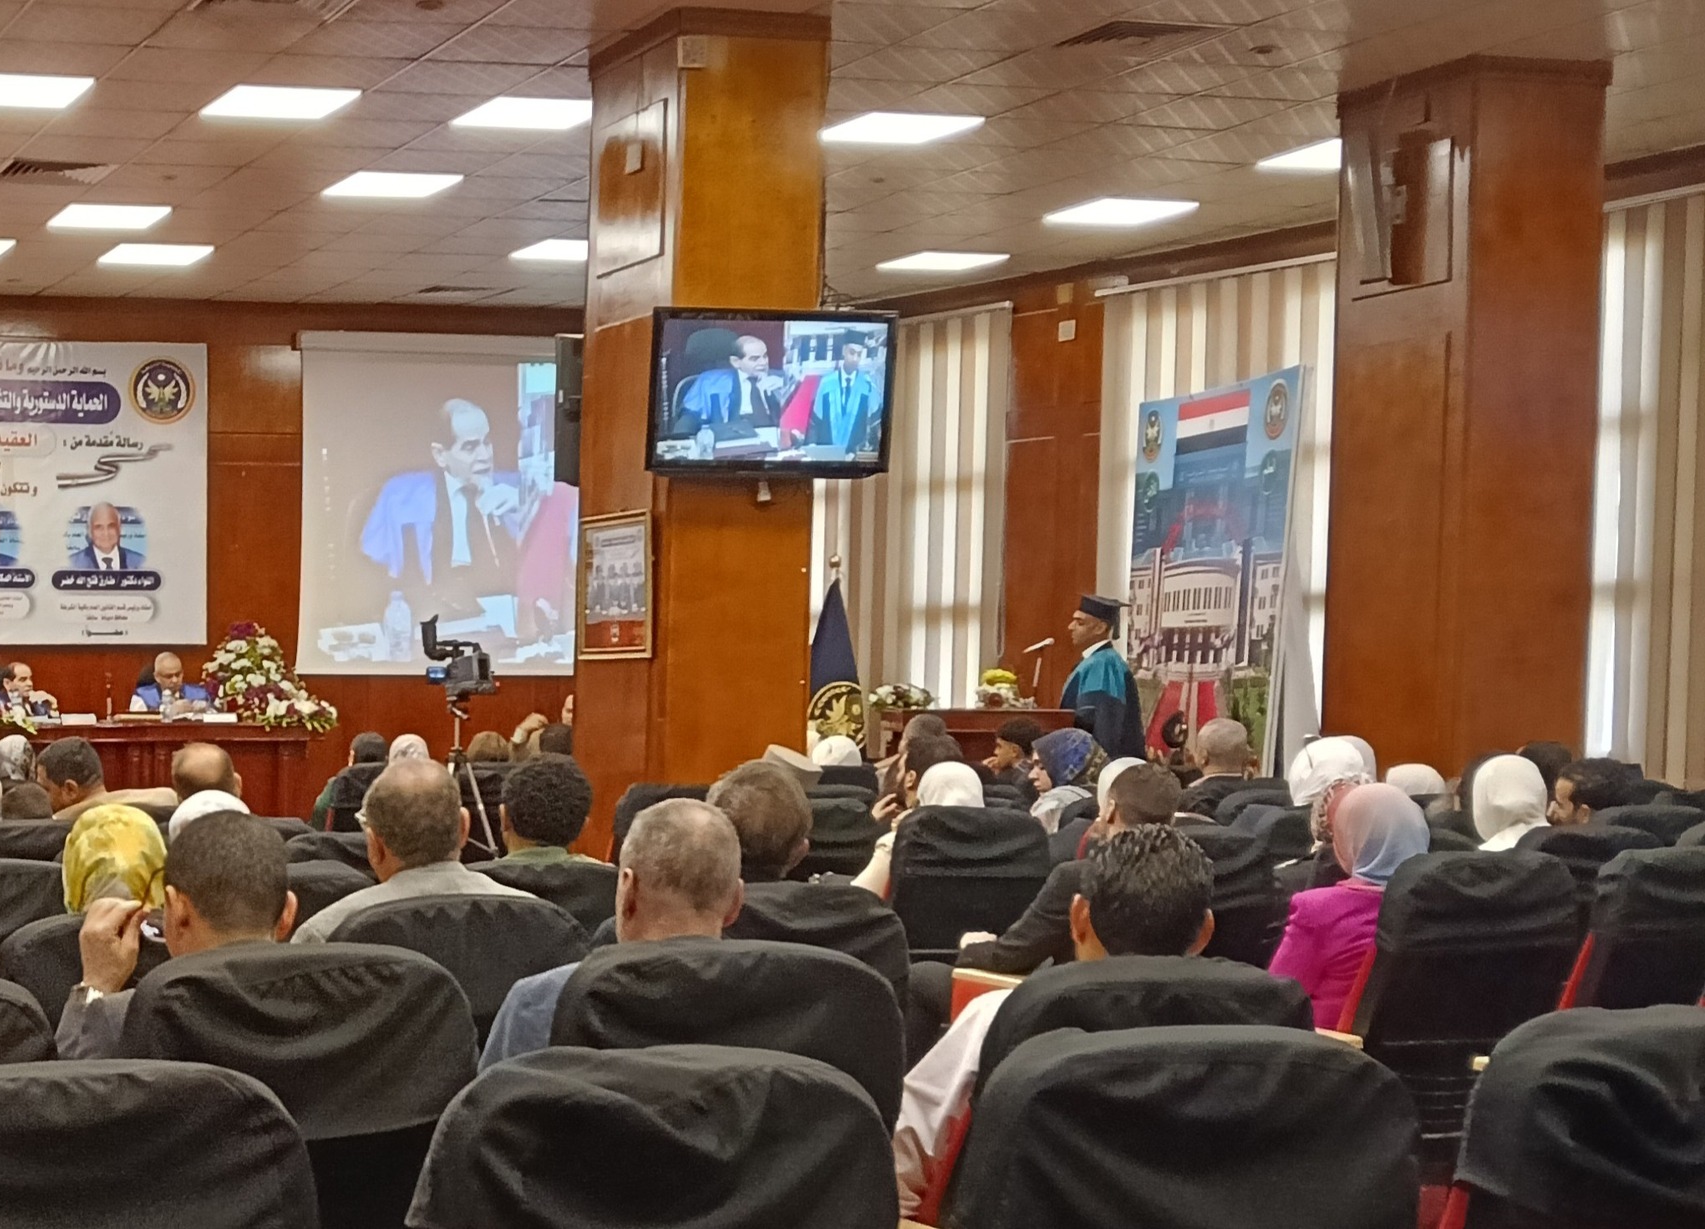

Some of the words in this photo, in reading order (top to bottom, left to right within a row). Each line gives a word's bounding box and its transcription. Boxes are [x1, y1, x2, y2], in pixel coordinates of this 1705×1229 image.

[22, 388, 71, 416] الدستورية
[71, 389, 108, 418] الحماية
[70, 436, 83, 450] من
[115, 434, 144, 450] رسالة
